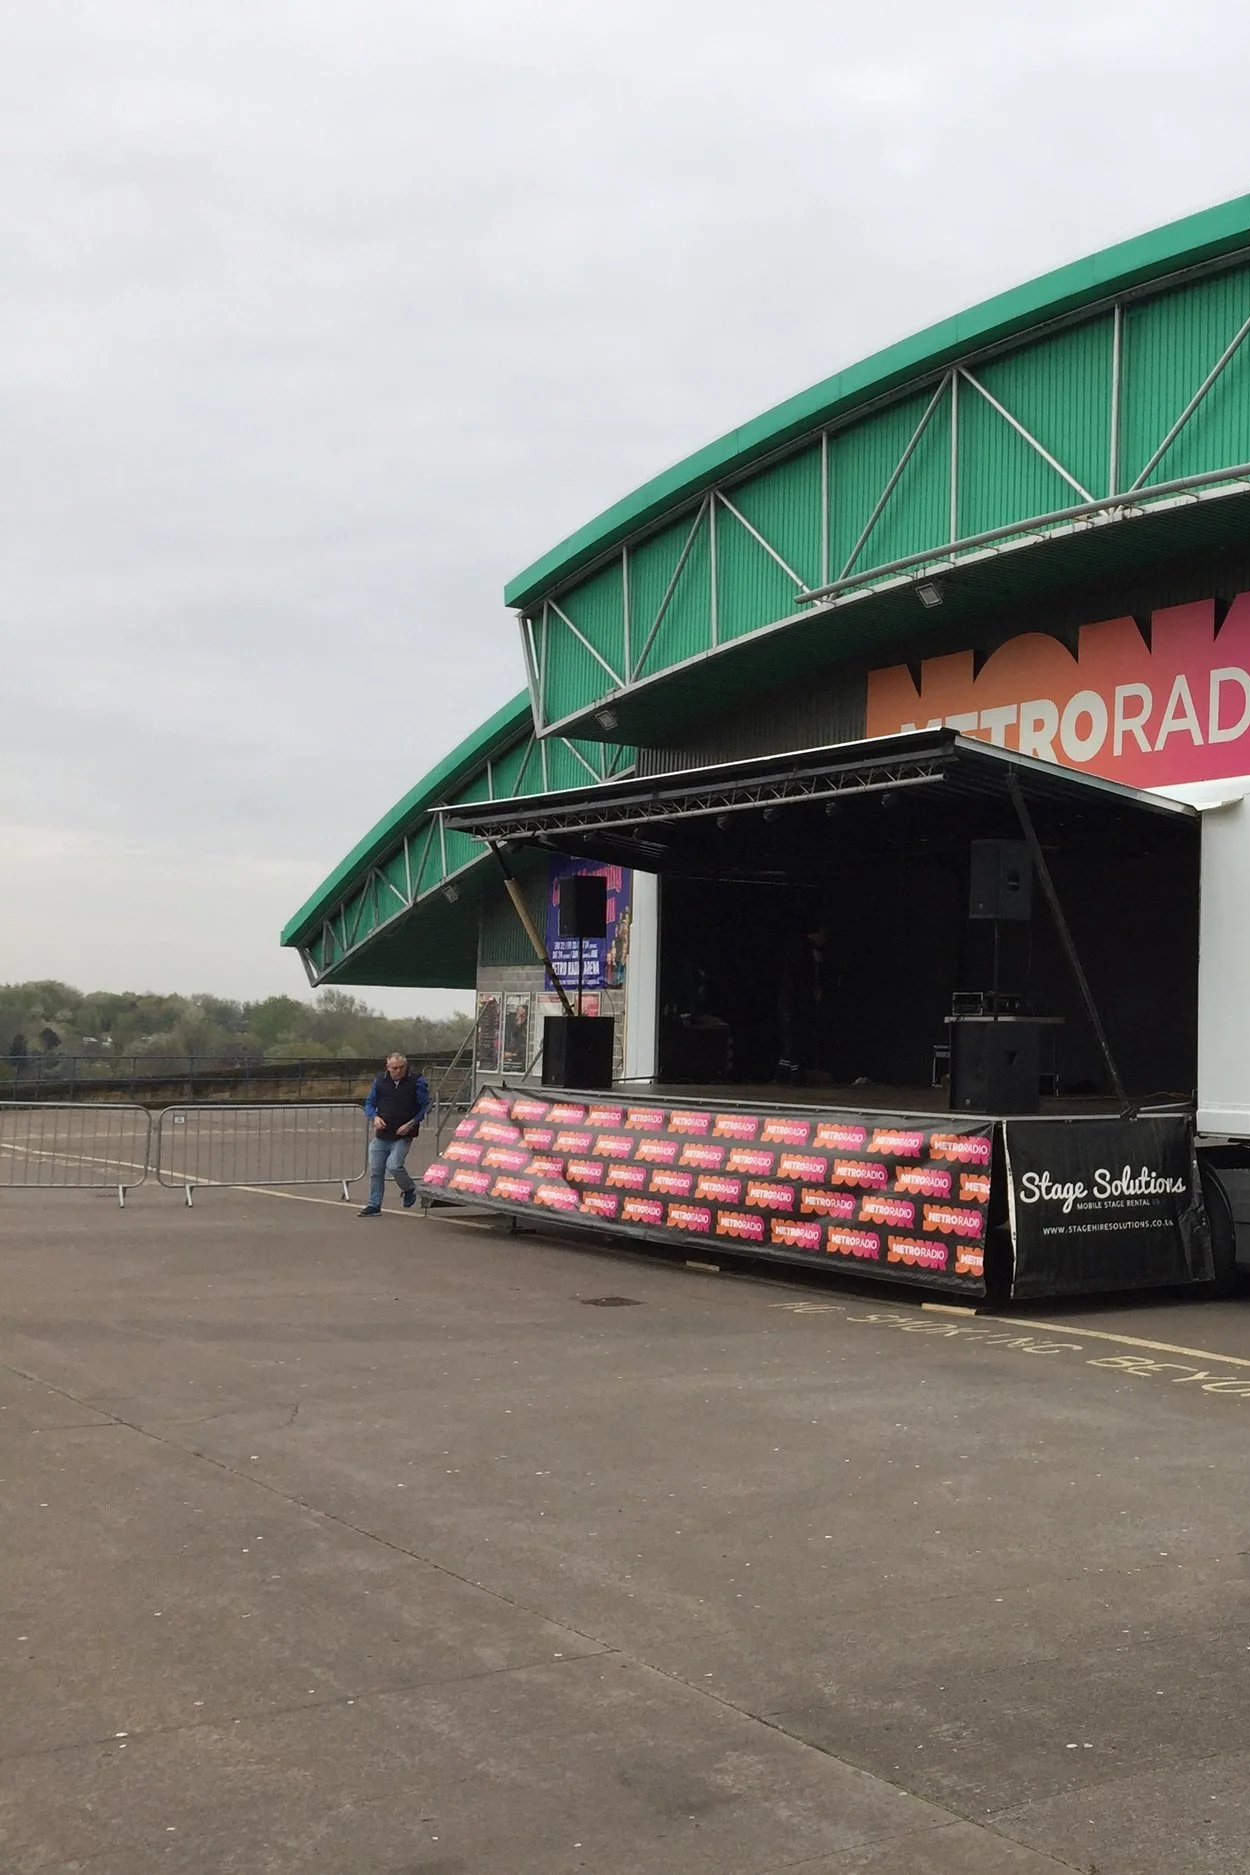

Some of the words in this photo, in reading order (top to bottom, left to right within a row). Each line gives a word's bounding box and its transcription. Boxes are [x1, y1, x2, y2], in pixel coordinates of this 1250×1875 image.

[767, 1125, 807, 1137] METRORADIO
[819, 1129, 863, 1143] METRORADIO
[935, 1141, 988, 1155] METRORADIO
[783, 1161, 825, 1174] METRORADIO
[836, 1166, 885, 1181] METRORADIO
[901, 1174, 949, 1189] METRORADIO
[750, 1189, 791, 1202] METRORADIO
[1020, 1171, 1088, 1213] Stage
[1093, 1165, 1186, 1199] Solutions
[804, 1195, 853, 1210] METRORADIO
[1077, 1202, 1102, 1210] MOBILE
[1104, 1200, 1124, 1208] STAGE
[1126, 1199, 1150, 1207] RENTAL
[865, 1205, 912, 1219] METRORADIO
[720, 1219, 762, 1231] METRORADIO
[775, 1226, 819, 1240] METRORADIO
[832, 1234, 877, 1250] METRORADIO
[892, 1244, 945, 1260] METRORADIO
